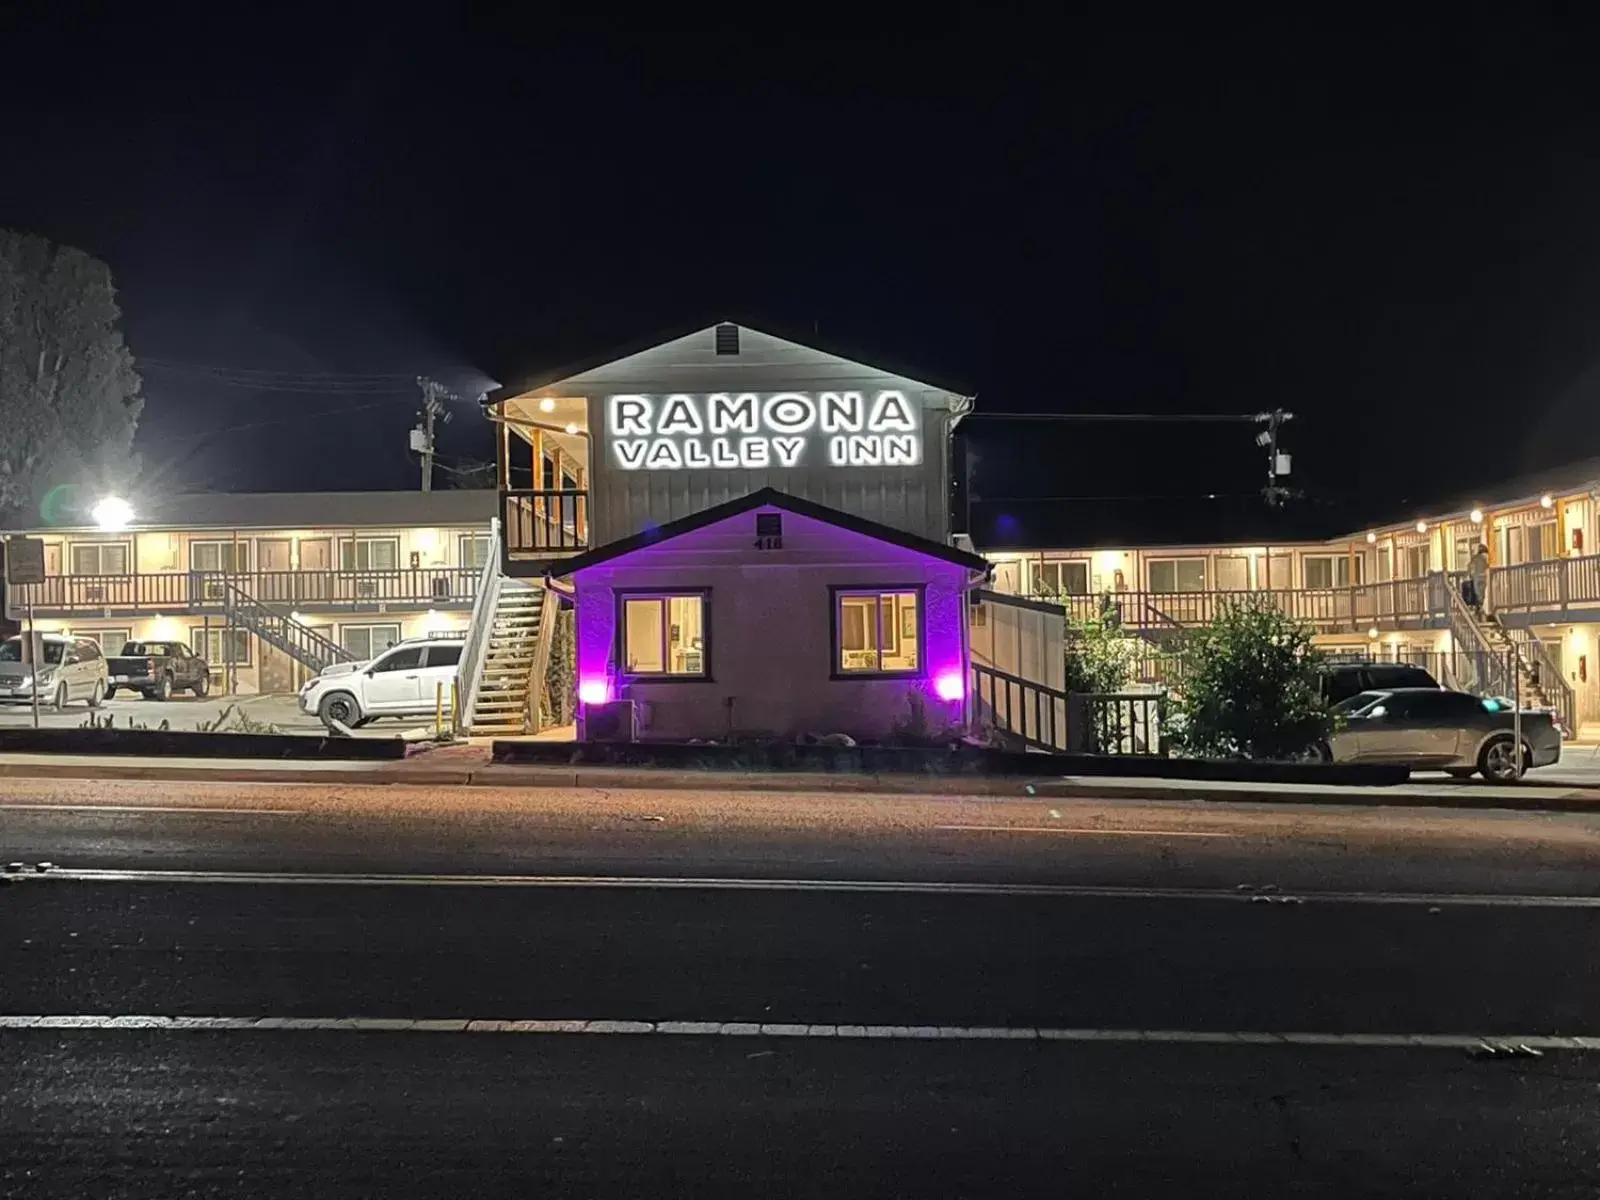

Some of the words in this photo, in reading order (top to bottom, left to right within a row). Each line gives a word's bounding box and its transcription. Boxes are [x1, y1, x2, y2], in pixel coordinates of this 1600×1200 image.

[614, 393, 913, 432] RAMONA
[615, 437, 803, 466] VALLEY
[834, 437, 914, 463] INN
